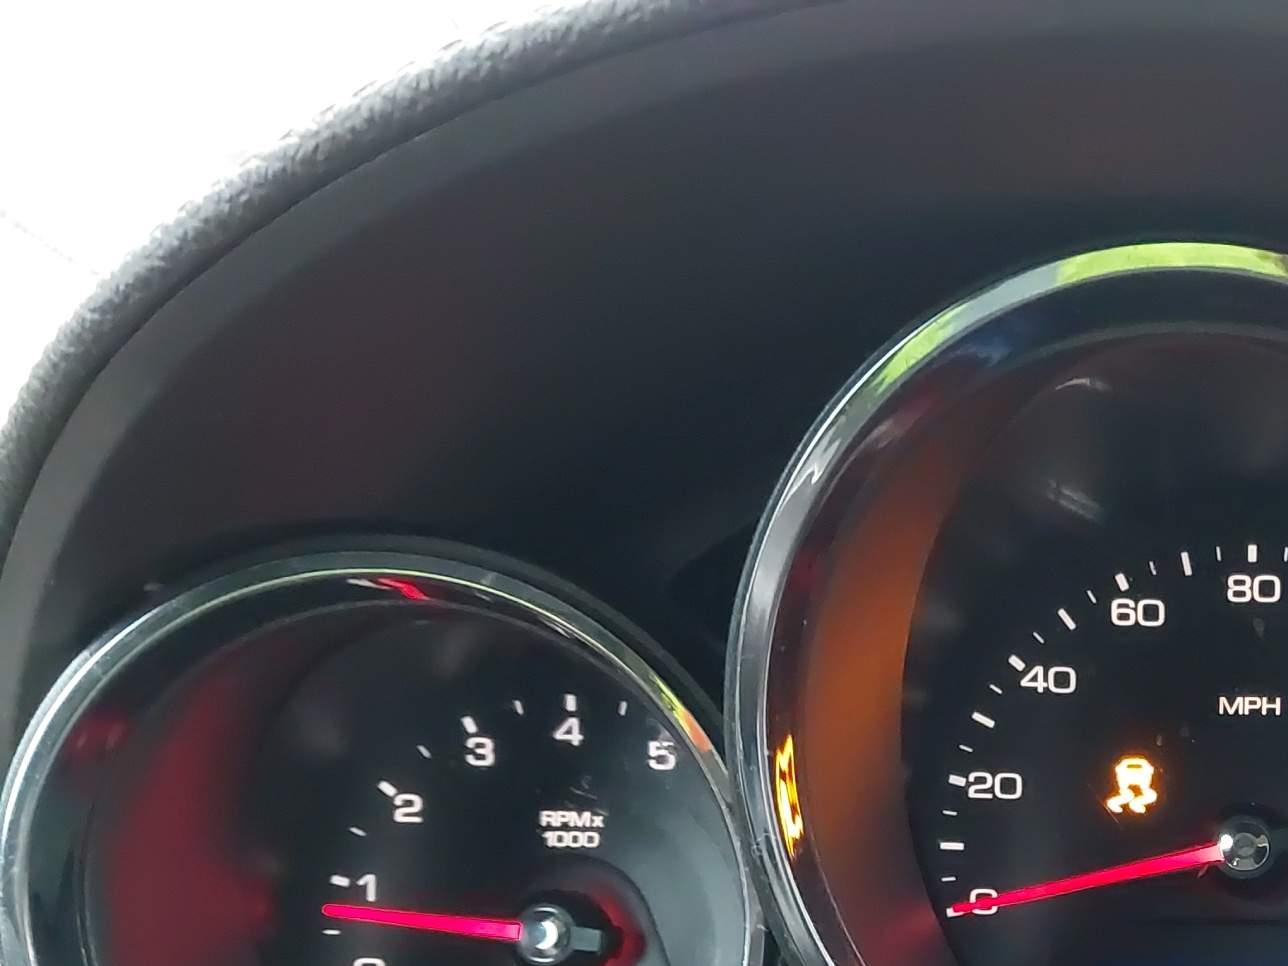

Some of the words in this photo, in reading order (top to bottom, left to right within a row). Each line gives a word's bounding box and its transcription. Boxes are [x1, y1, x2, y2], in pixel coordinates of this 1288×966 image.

[1227, 574, 1281, 603] 80
[1110, 598, 1165, 627] 60
[1019, 665, 1077, 694] 40
[1218, 696, 1281, 716] MPH
[553, 717, 584, 746] 4
[465, 736, 496, 767] 3
[647, 740, 676, 771] 5
[967, 772, 1023, 800] 20
[393, 792, 424, 823] 2
[539, 810, 604, 828] RPMx
[542, 830, 601, 848] 1000
[356, 874, 377, 902] 1
